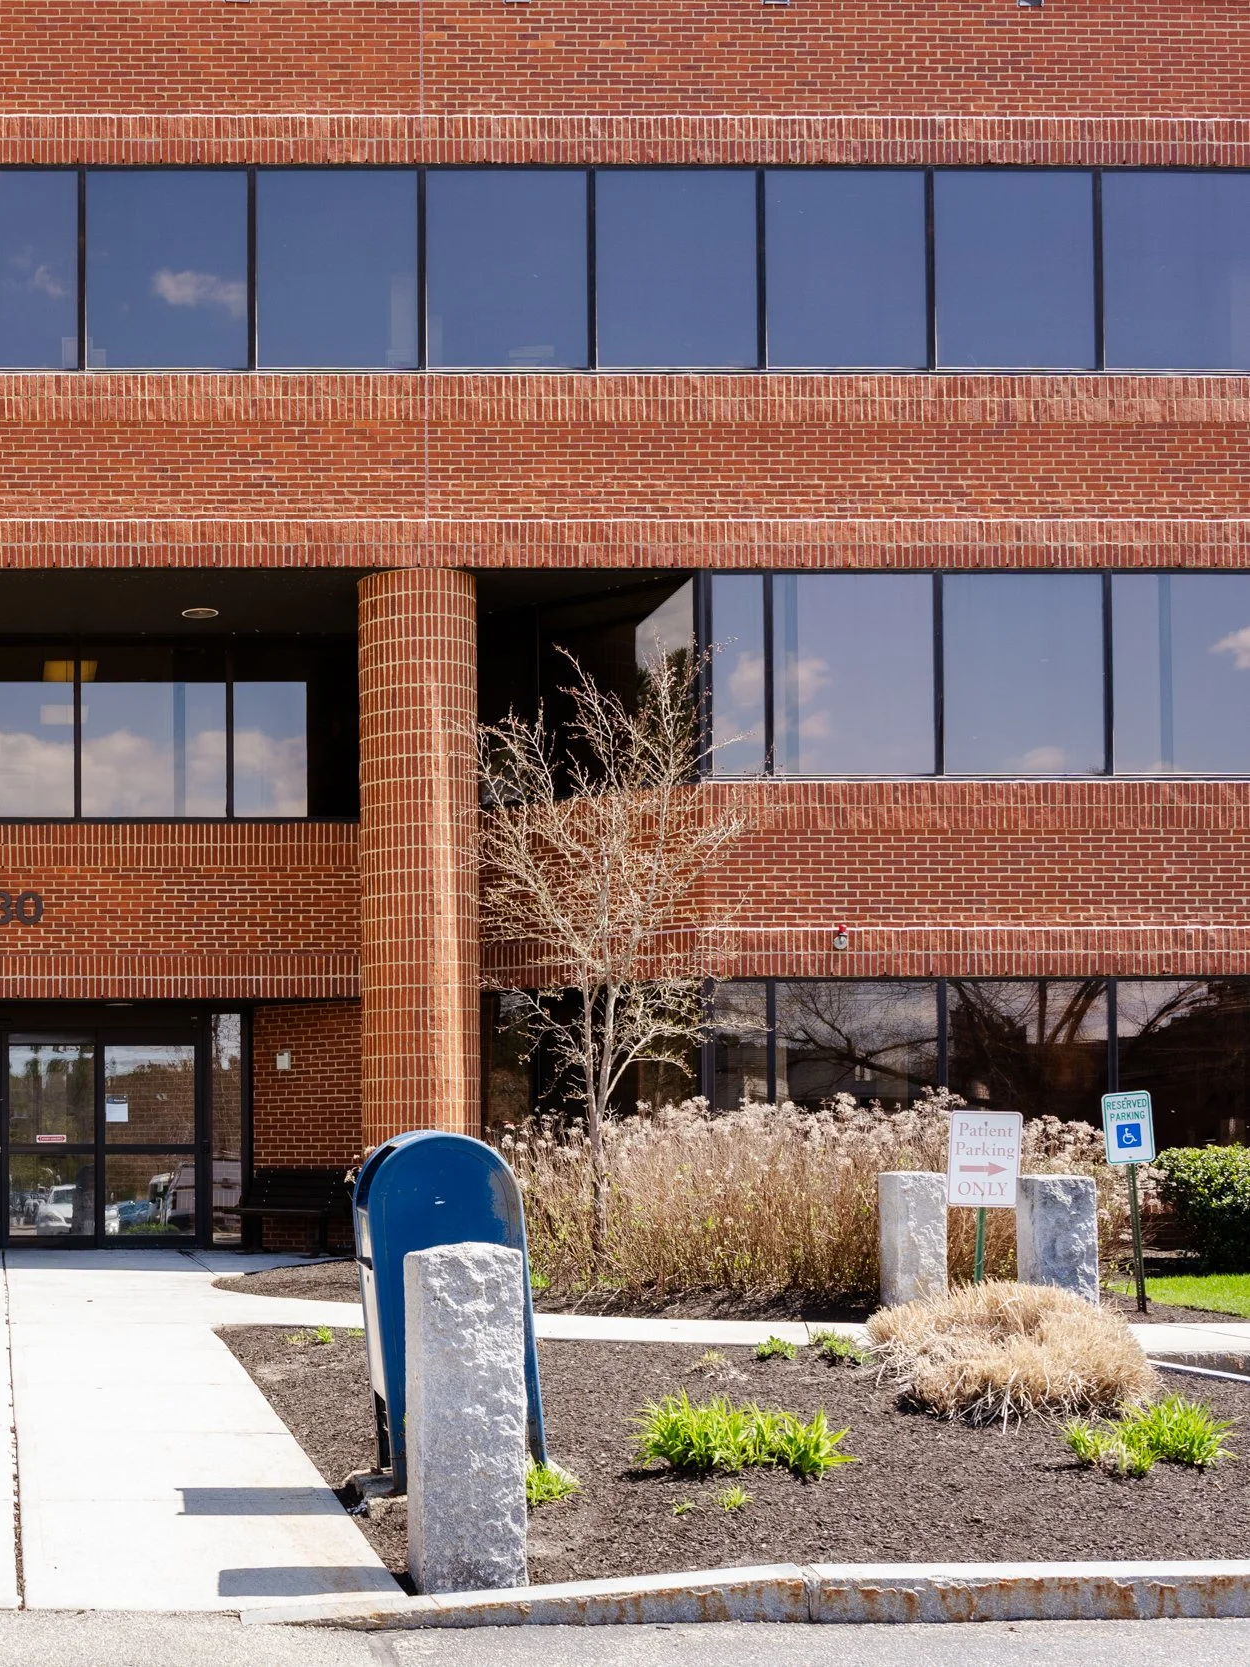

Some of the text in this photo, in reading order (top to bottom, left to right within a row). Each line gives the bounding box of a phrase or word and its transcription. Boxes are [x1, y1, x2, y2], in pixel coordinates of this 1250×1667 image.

[1106, 1098, 1147, 1110] RESERVED
[1110, 1110, 1146, 1121] PARKING
[958, 1122, 1014, 1137] Patient
[955, 1141, 1015, 1160] Parking
[958, 1181, 1008, 1196] ONLY
